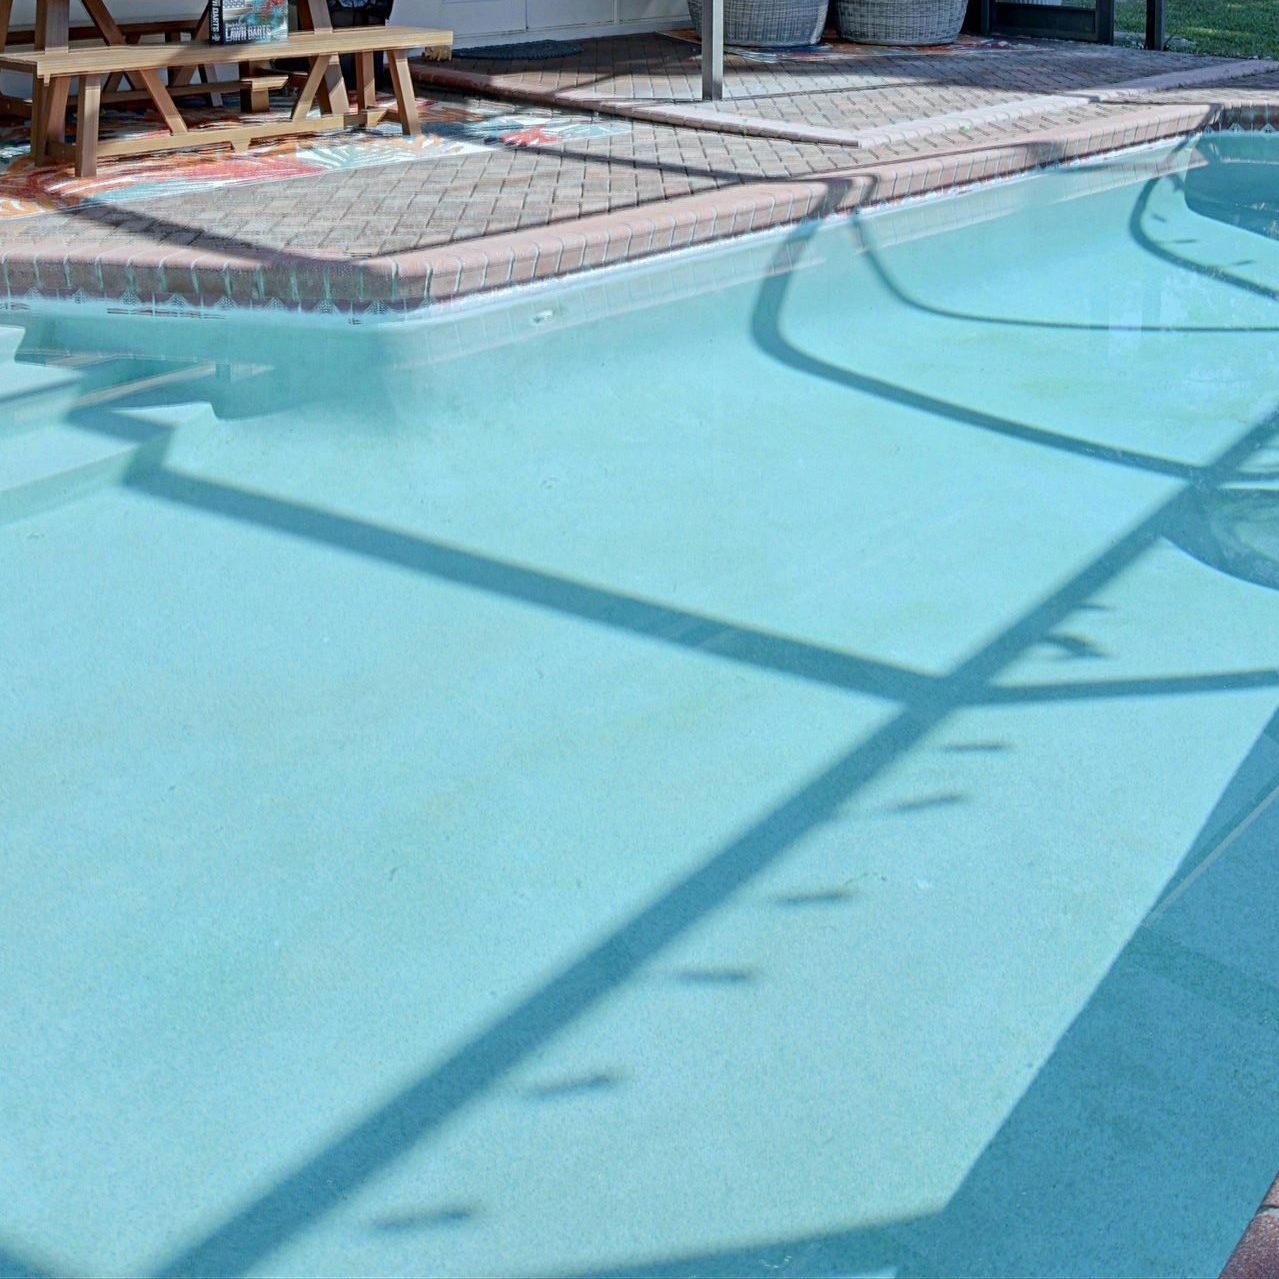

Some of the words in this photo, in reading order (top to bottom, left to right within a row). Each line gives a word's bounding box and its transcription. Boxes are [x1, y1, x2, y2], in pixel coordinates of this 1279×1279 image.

[211, 7, 220, 33] DARTS
[225, 26, 247, 42] LAWN
[248, 24, 272, 40] DARTS
